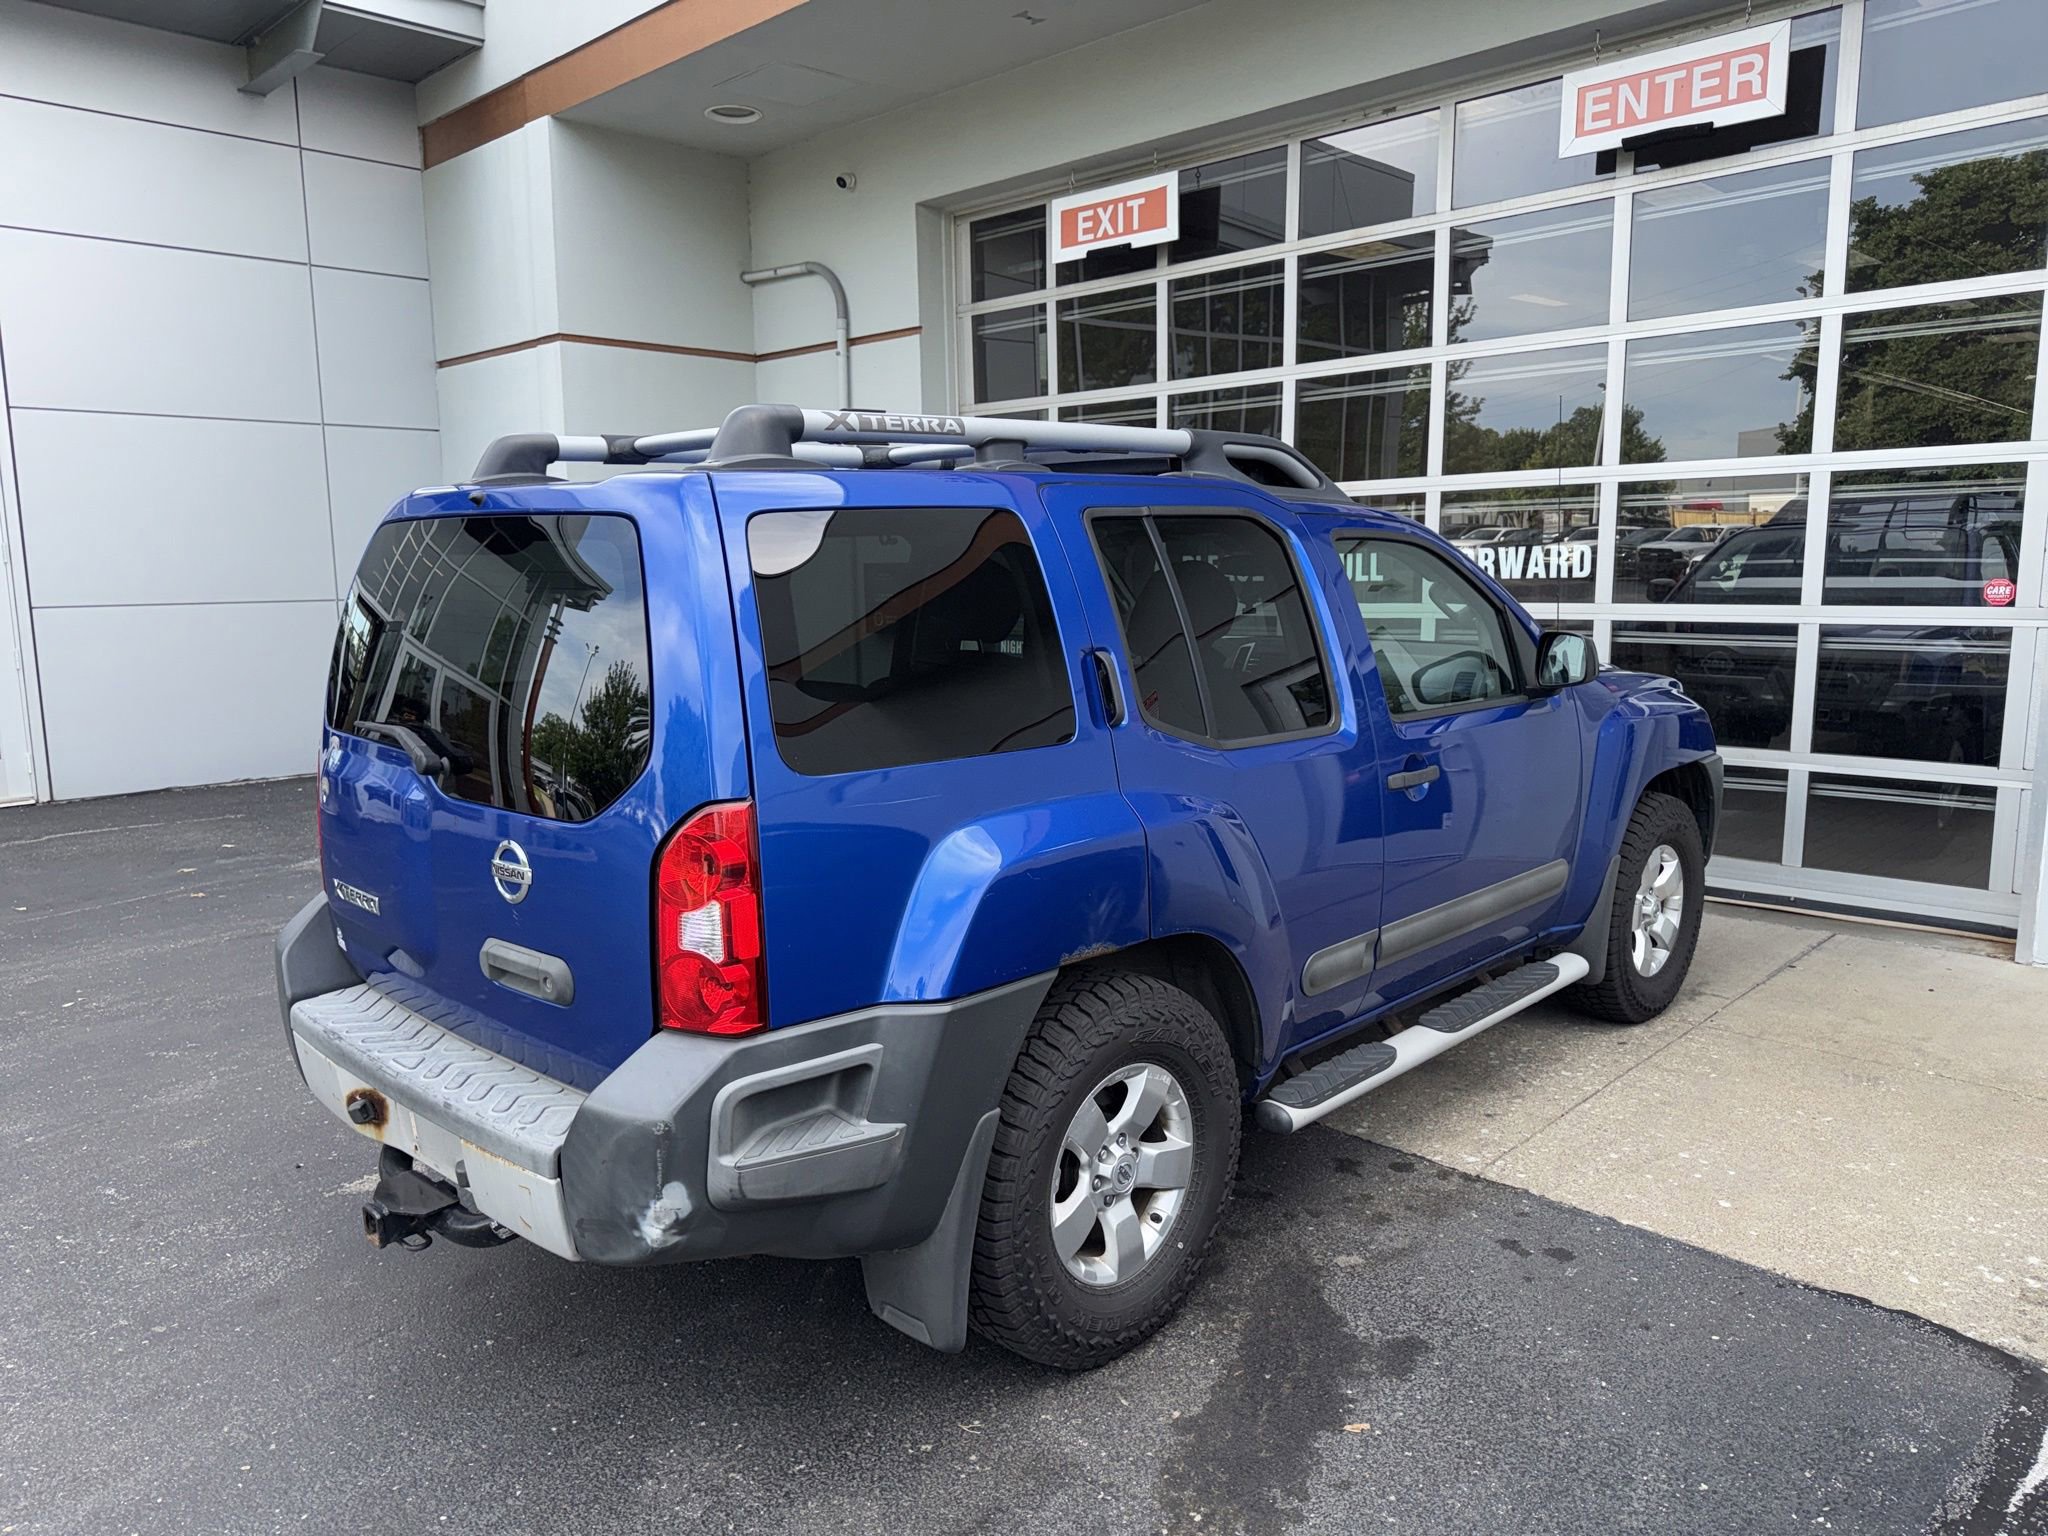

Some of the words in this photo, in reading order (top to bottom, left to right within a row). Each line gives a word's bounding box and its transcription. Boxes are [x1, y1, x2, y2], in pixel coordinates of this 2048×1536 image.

[1583, 53, 1764, 132] ENTER
[1077, 197, 1146, 242] EXIT
[822, 411, 966, 436] XTERRA
[1338, 552, 1384, 582] ULL
[1457, 544, 1592, 580] RWARD
[1986, 585, 2012, 595] CARE
[1000, 639, 1024, 654] NIGH
[492, 863, 525, 881] NISSAN
[1128, 1023, 1223, 1096] FALKEN
